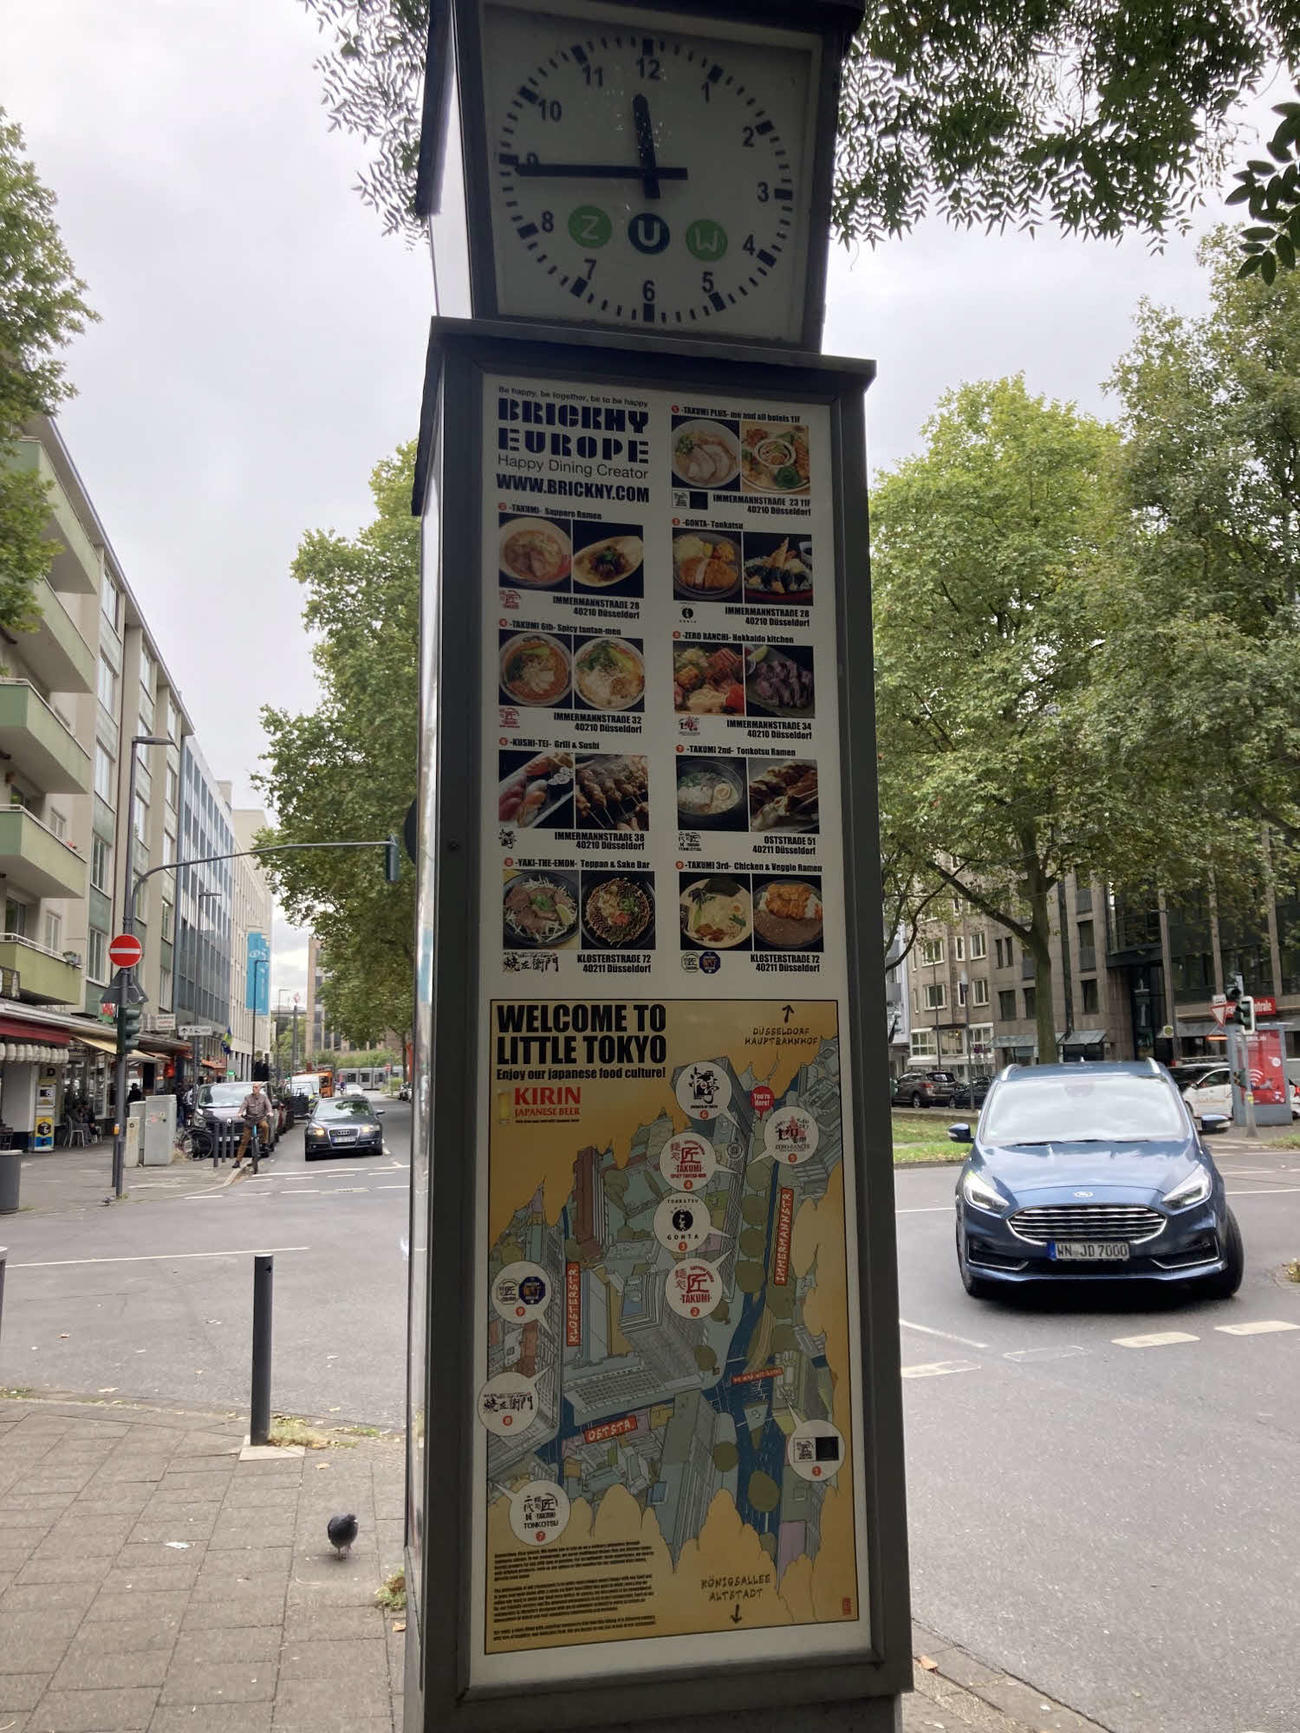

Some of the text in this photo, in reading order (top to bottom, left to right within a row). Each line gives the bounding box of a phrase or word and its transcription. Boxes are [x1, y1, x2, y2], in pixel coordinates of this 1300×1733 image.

[582, 64, 604, 87] 11
[636, 58, 661, 80] 12
[702, 82, 711, 102] 1
[538, 101, 562, 122] 10
[742, 127, 755, 148] 2
[757, 182, 770, 203] 3
[541, 211, 554, 232] 8
[580, 216, 598, 240] Z
[637, 219, 660, 247] U
[742, 234, 755, 256] 4
[584, 258, 597, 280] 7
[643, 280, 656, 301] 6
[702, 271, 714, 293] 5
[540, 390, 550, 398] be
[602, 396, 610, 404] to
[612, 396, 622, 404] be
[624, 398, 648, 408] happy
[498, 398, 649, 434] BRICKNY
[498, 427, 649, 464] EUROPE
[498, 454, 649, 480] Happy Dining Creator
[496, 473, 650, 503] WWW.BRICKNY.COM
[747, 506, 811, 516] 40210 Düsseldorf
[574, 607, 640, 619] 40210 Düsseldorf
[745, 618, 810, 626] 40210 Düsseldorf
[575, 722, 642, 734] 40210 Düsseldorf
[632, 716, 642, 724] 32
[747, 730, 812, 740] 40210 Düsseldorf
[554, 740, 570, 749] Grill
[578, 742, 600, 750] Sushi
[771, 748, 796, 756] Ramen
[576, 842, 645, 850] 40210 Düsseldorf
[752, 846, 816, 855] 40211 Düsseldorf
[580, 860, 609, 868] Teppan
[617, 860, 636, 868] Sake
[637, 860, 650, 868] Bar
[734, 862, 764, 871] Chicken
[772, 863, 796, 872] Veggie
[798, 864, 823, 872] Ramen
[642, 955, 652, 964] 72
[756, 964, 820, 972] 40211 Düsseldorf
[812, 955, 820, 964] 72
[582, 964, 652, 973] 40211 Düsseldorf
[497, 1004, 666, 1032] WELCOME TO
[497, 1034, 666, 1064] LITTLE TOKYO
[496, 1068, 525, 1081] Enjoy
[528, 1070, 546, 1080] our
[600, 1067, 622, 1078] food
[624, 1066, 666, 1078] culture!
[514, 1086, 582, 1106] KIRIN
[514, 1107, 580, 1118] JAPANESE BEER
[1080, 1244, 1094, 1257] JD
[1098, 1244, 1127, 1256] 7000
[700, 1574, 771, 1590] KÖNIGSALLEE
[709, 1588, 763, 1600] ALTSTADT
